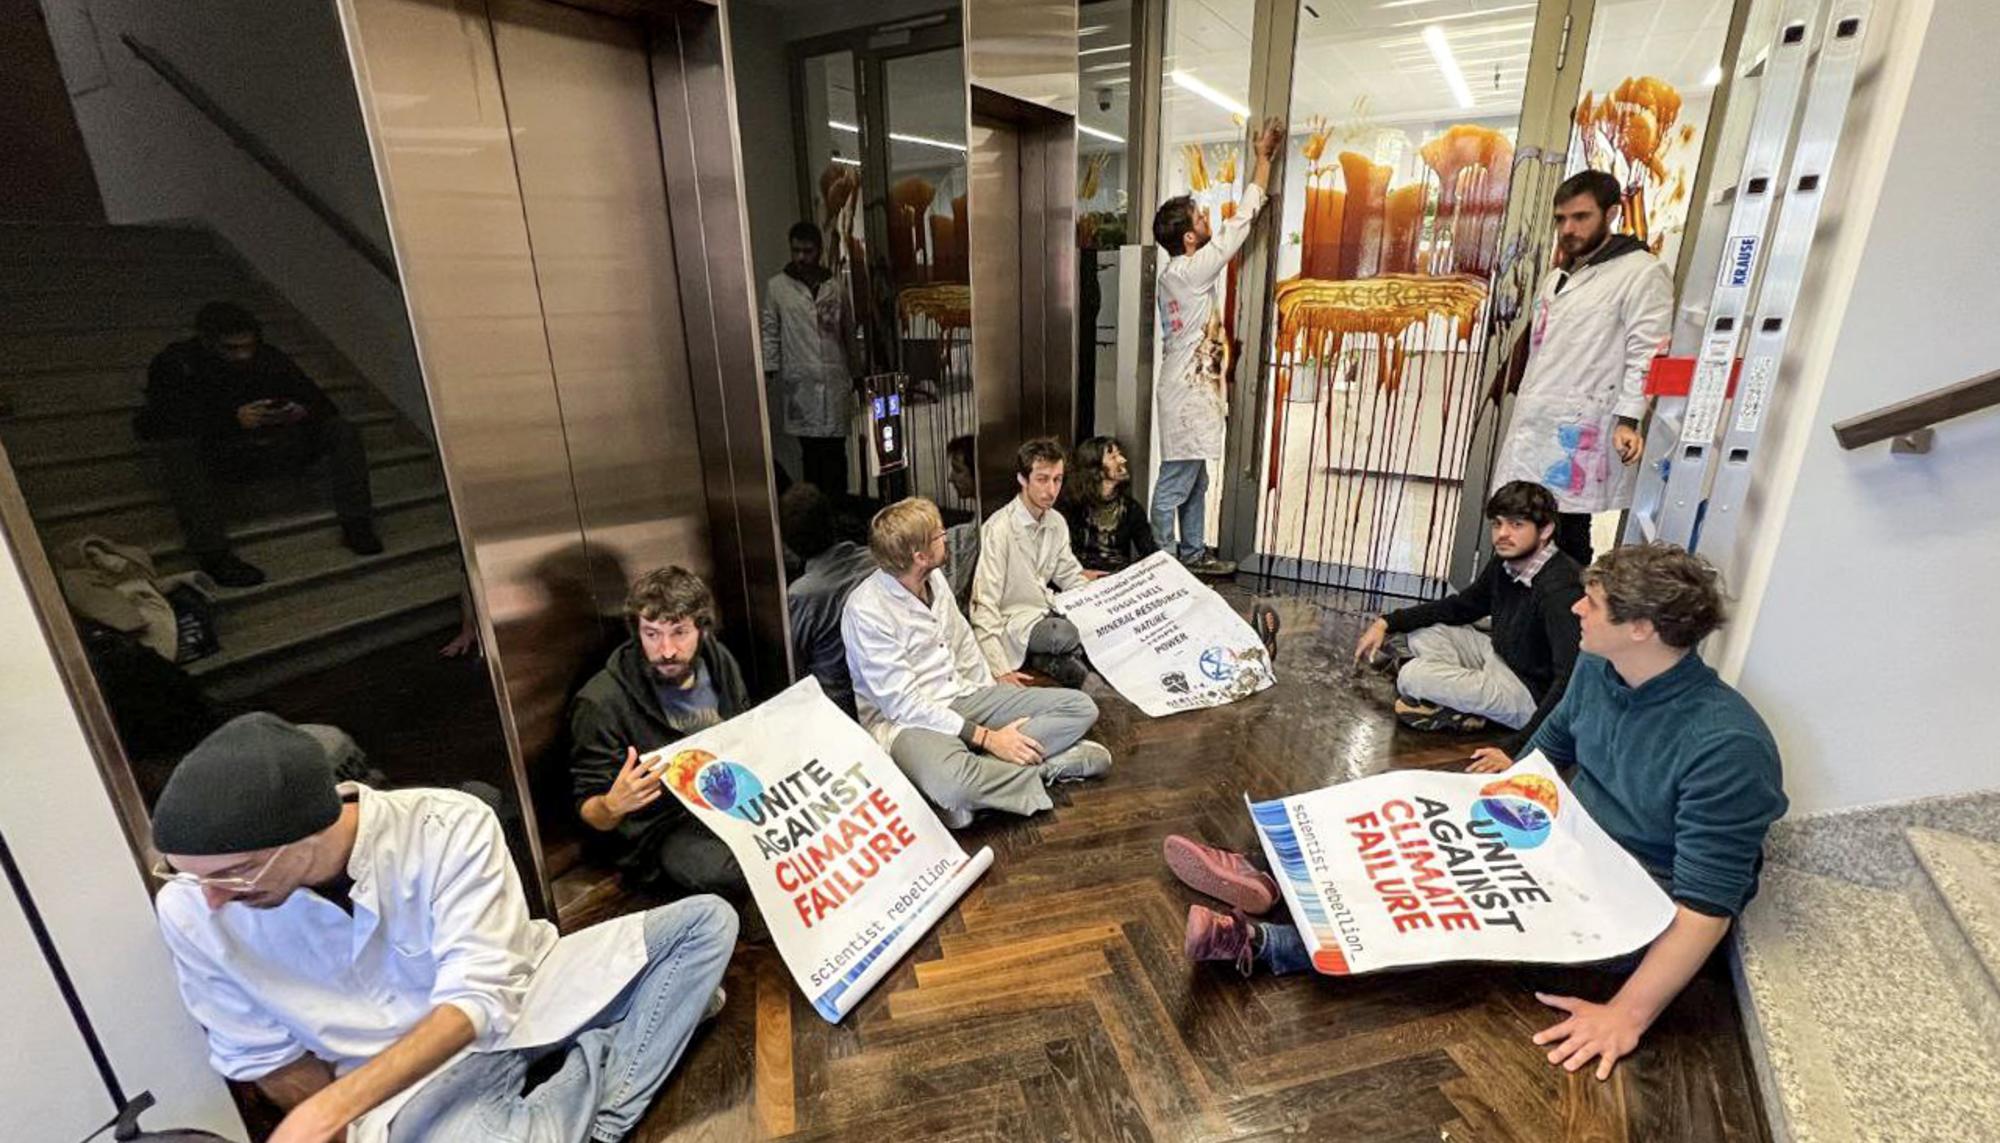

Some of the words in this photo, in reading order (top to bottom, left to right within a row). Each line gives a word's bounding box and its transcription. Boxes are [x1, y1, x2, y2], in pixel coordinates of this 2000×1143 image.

[1732, 239, 1755, 285] KRAUSE
[1095, 613, 1135, 638] MINERAL
[1135, 587, 1189, 617] RESSOURCES
[1133, 612, 1168, 634] NATURE
[1154, 632, 1188, 654] POWER
[738, 758, 832, 826] UNITE
[752, 762, 872, 860] AGAINST
[775, 787, 899, 892] CLIMATE
[794, 817, 917, 928] FAILURE
[1293, 803, 1329, 872] scientist
[1345, 811, 1434, 933] FAILURE
[1381, 799, 1481, 931] CLIMATE
[1415, 796, 1525, 933] AGAINST
[1466, 818, 1552, 903] UNITE
[810, 920, 885, 987] scientist
